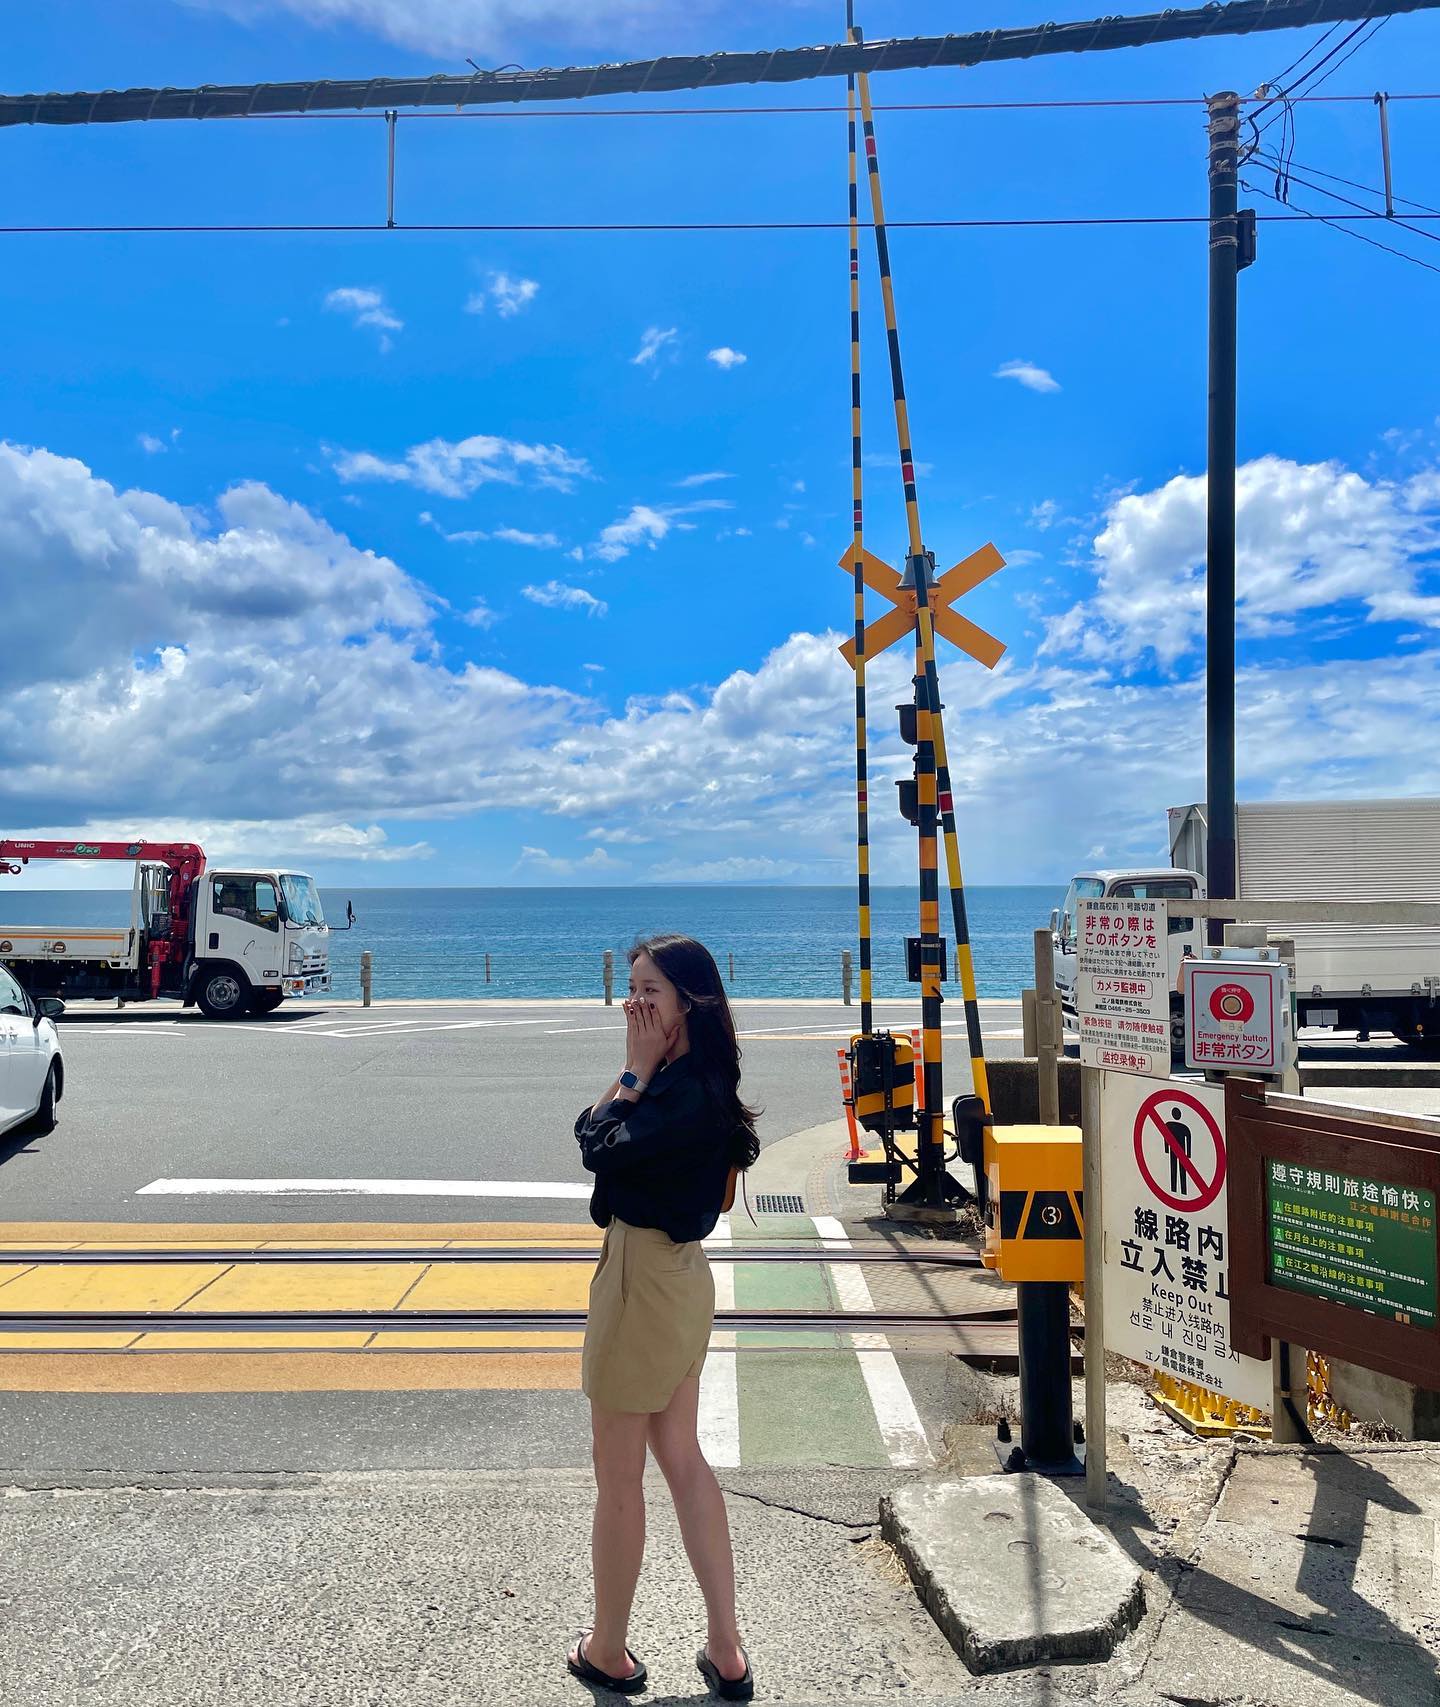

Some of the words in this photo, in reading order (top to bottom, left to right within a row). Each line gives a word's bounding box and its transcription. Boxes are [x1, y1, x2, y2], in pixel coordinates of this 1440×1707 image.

[1086, 915, 1155, 931] 非常の際は
[1085, 932, 1157, 948] このボタンを
[1097, 981, 1146, 995] カメラ監視中
[1197, 1030, 1239, 1042] Emergency
[1242, 1033, 1268, 1042] button
[1102, 1051, 1146, 1069] 监控录像中
[1197, 1041, 1269, 1060] 非常ボタン
[1134, 1206, 1224, 1262] 線路内
[1151, 1282, 1183, 1307] Keep
[1188, 1295, 1213, 1315] Out
[1142, 1297, 1225, 1339] 禁止进入线路内
[1130, 1310, 1154, 1331] 선로
[1161, 1321, 1173, 1339] 내
[1182, 1328, 1207, 1351] 진입
[1145, 1350, 1224, 1389] 江ノ島電鉄株式会社
